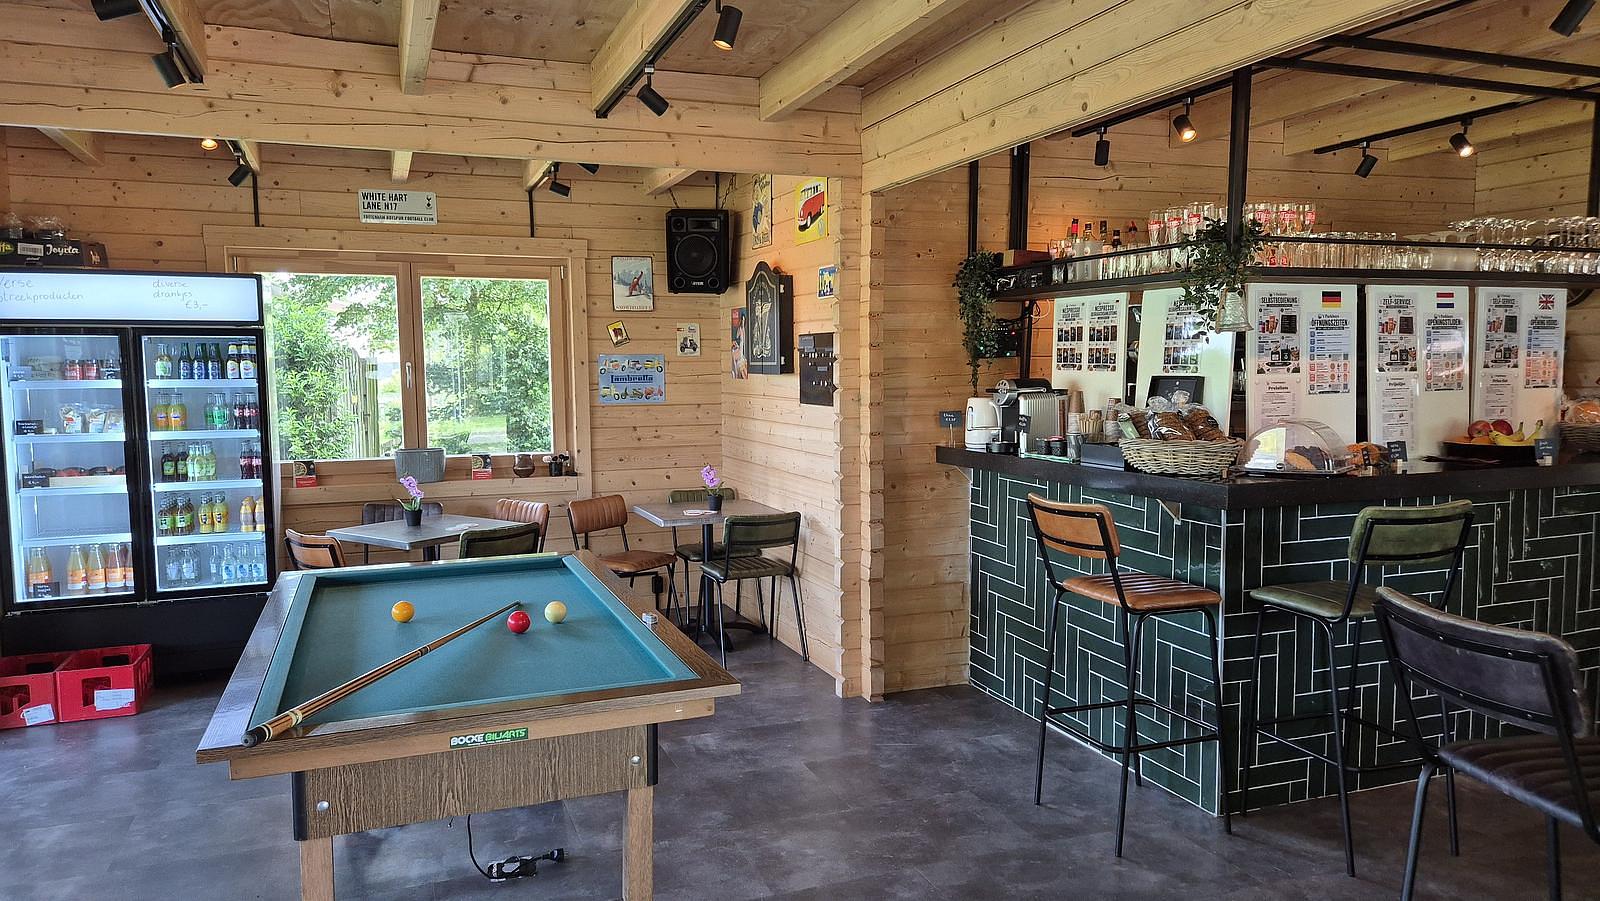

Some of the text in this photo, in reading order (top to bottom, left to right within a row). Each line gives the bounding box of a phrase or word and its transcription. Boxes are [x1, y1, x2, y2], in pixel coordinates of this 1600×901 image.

[361, 192, 408, 202] WHITE HART
[362, 201, 398, 210] LANE N17
[152, 279, 190, 288] diverse
[450, 734, 485, 746] BOCKE
